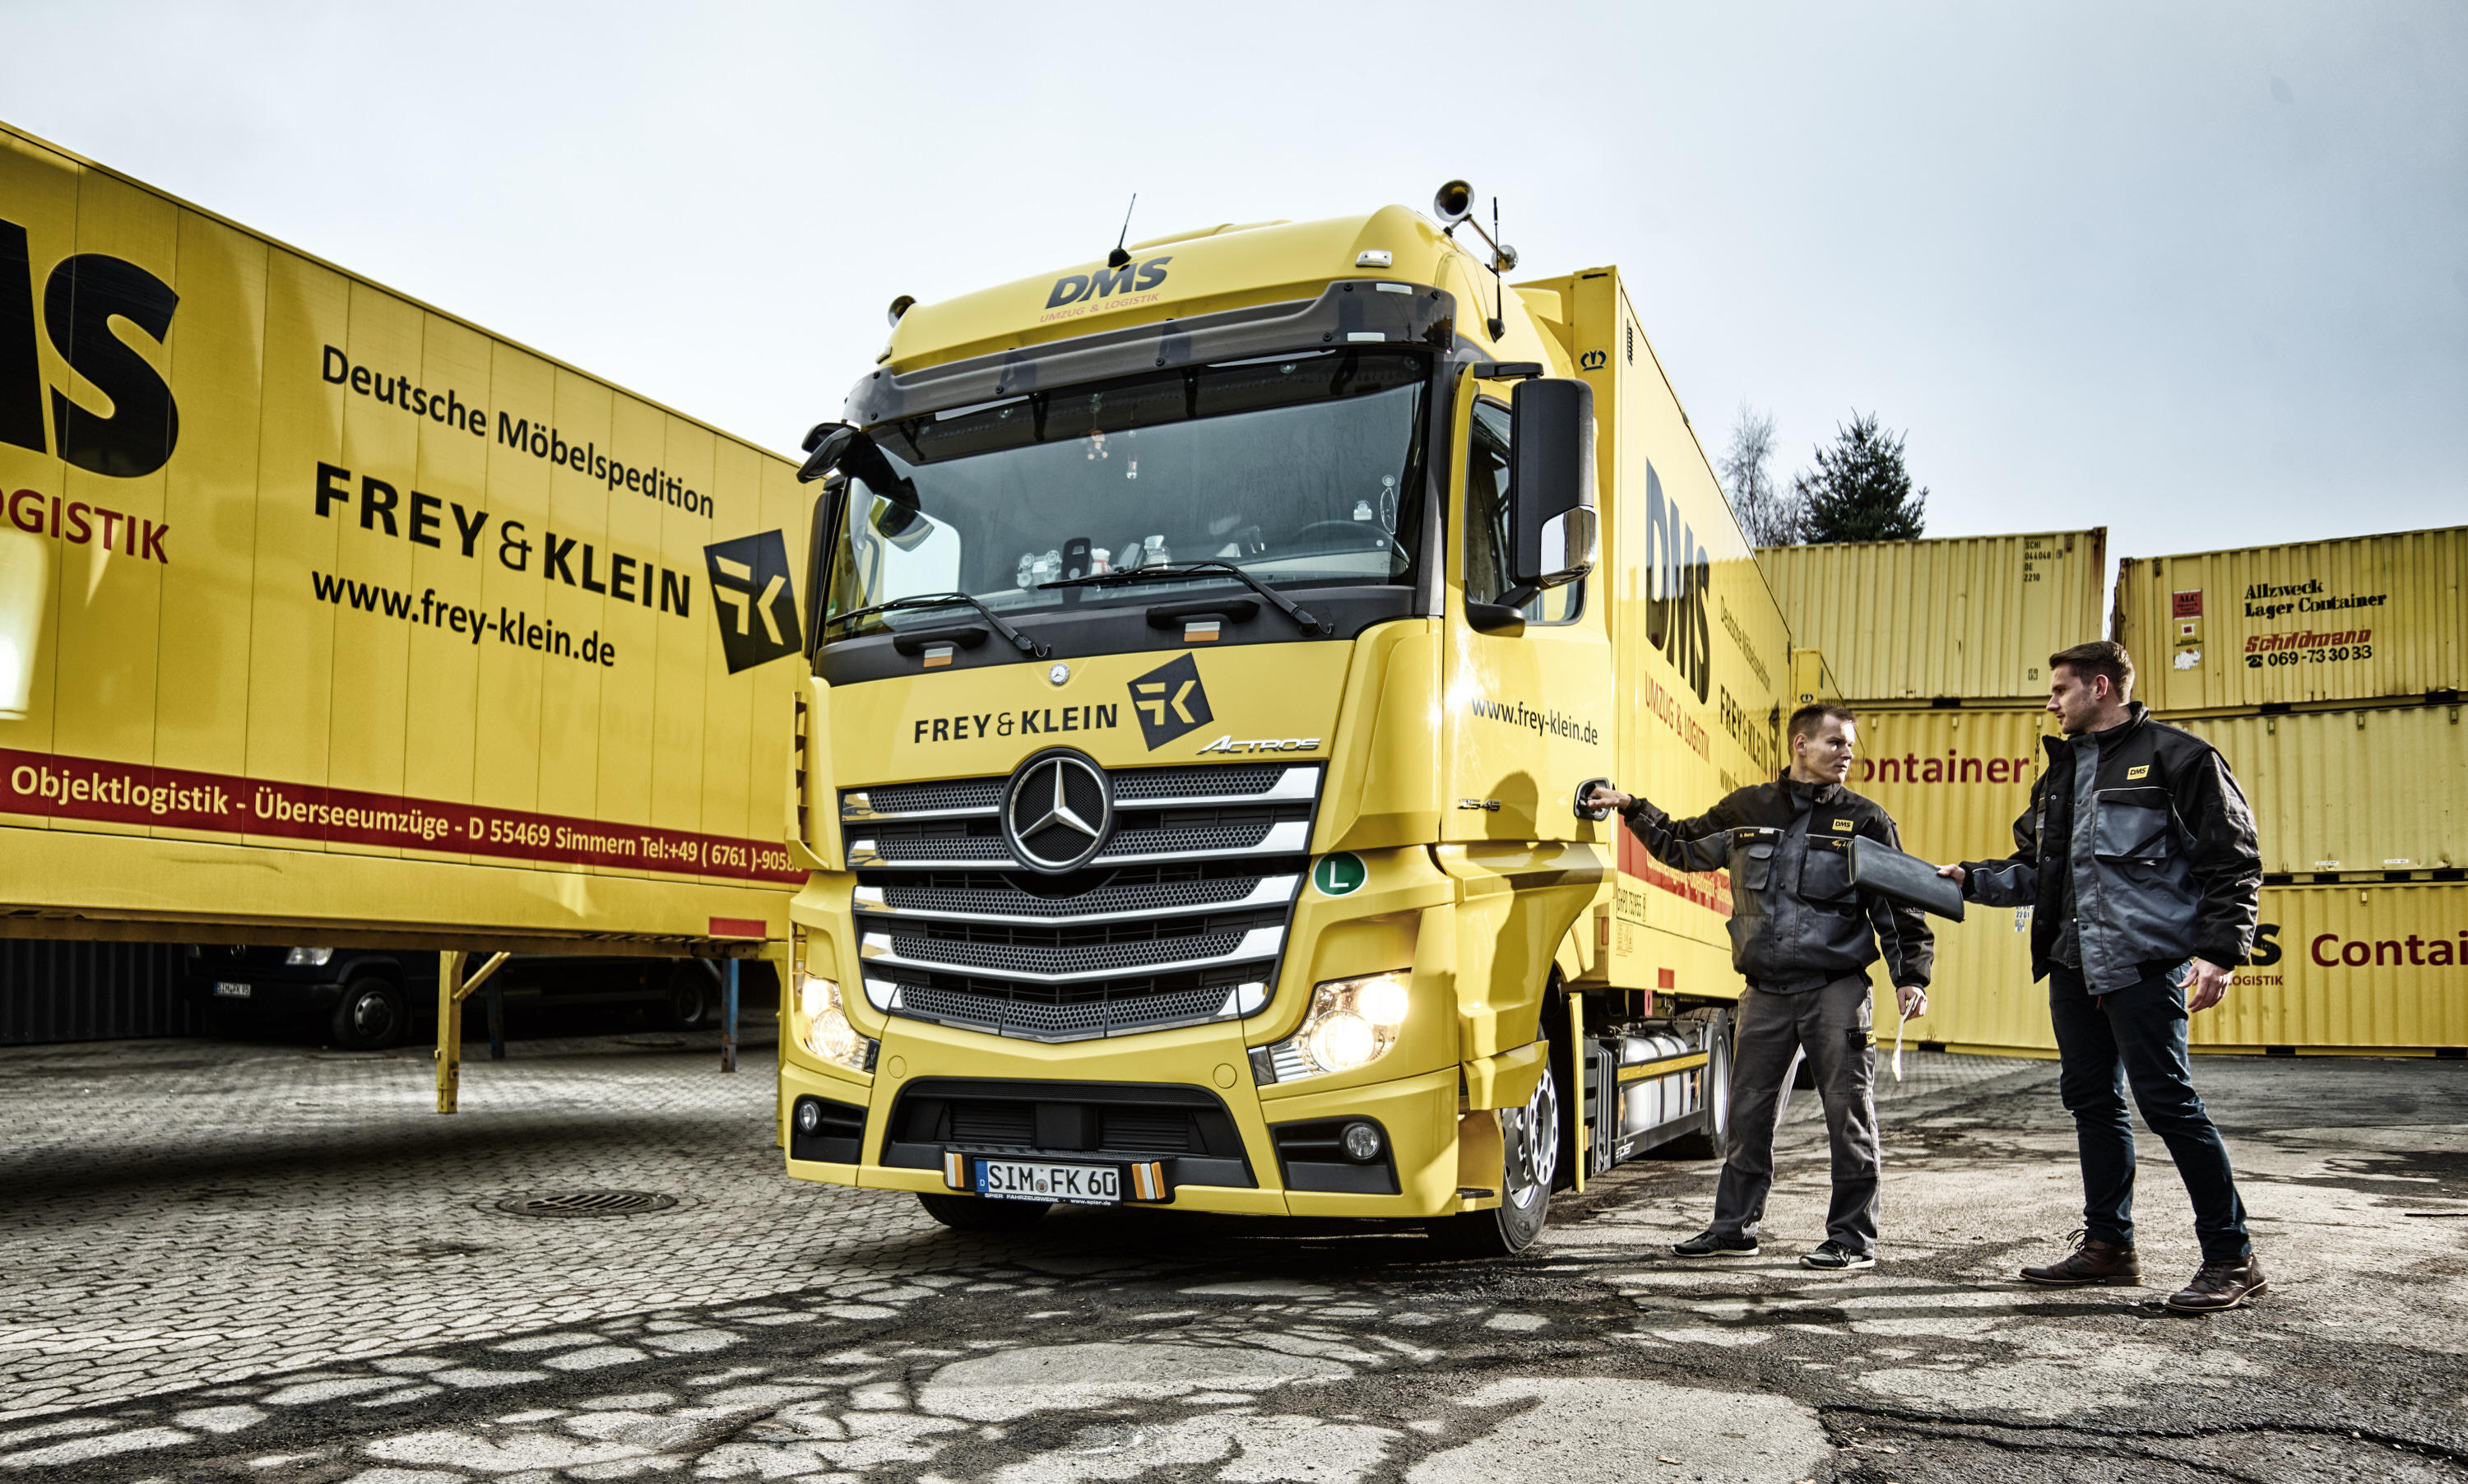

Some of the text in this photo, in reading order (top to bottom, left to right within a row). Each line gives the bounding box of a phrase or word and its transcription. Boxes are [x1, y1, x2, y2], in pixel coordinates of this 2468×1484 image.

[1045, 256, 1173, 310] DMS
[1040, 293, 1160, 323] UMZUG & LOGISTIK
[322, 344, 714, 520] Deutsche Möbelspedition
[0, 487, 170, 565] GISTIK
[1645, 456, 1710, 706] DMS
[2024, 562, 2034, 572] DE
[2244, 578, 2324, 600] Allzweck
[312, 571, 615, 668] www.frey-klein.de
[2244, 593, 2387, 619] Lager Container
[2244, 629, 2373, 652] Schildmann
[1471, 697, 1598, 746] www.frey-klein.de
[1645, 670, 1710, 764] UMZUG & LOGISTIK
[1863, 749, 2030, 784] ontainer
[2129, 768, 2147, 776] DMS
[11, 765, 230, 816] Objektlogistik
[254, 786, 448, 842] Überseeumzüge
[469, 816, 485, 840] D
[489, 819, 550, 846] 55469
[554, 826, 636, 856] Simmern
[750, 846, 803, 873] )-9058
[1329, 861, 1349, 888] L
[989, 1164, 1034, 1191] SIM
[1051, 1168, 1080, 1195] FK
[1088, 1170, 1117, 1196] 60
[1006, 1194, 1059, 1203] FAHRZEUGWERK
